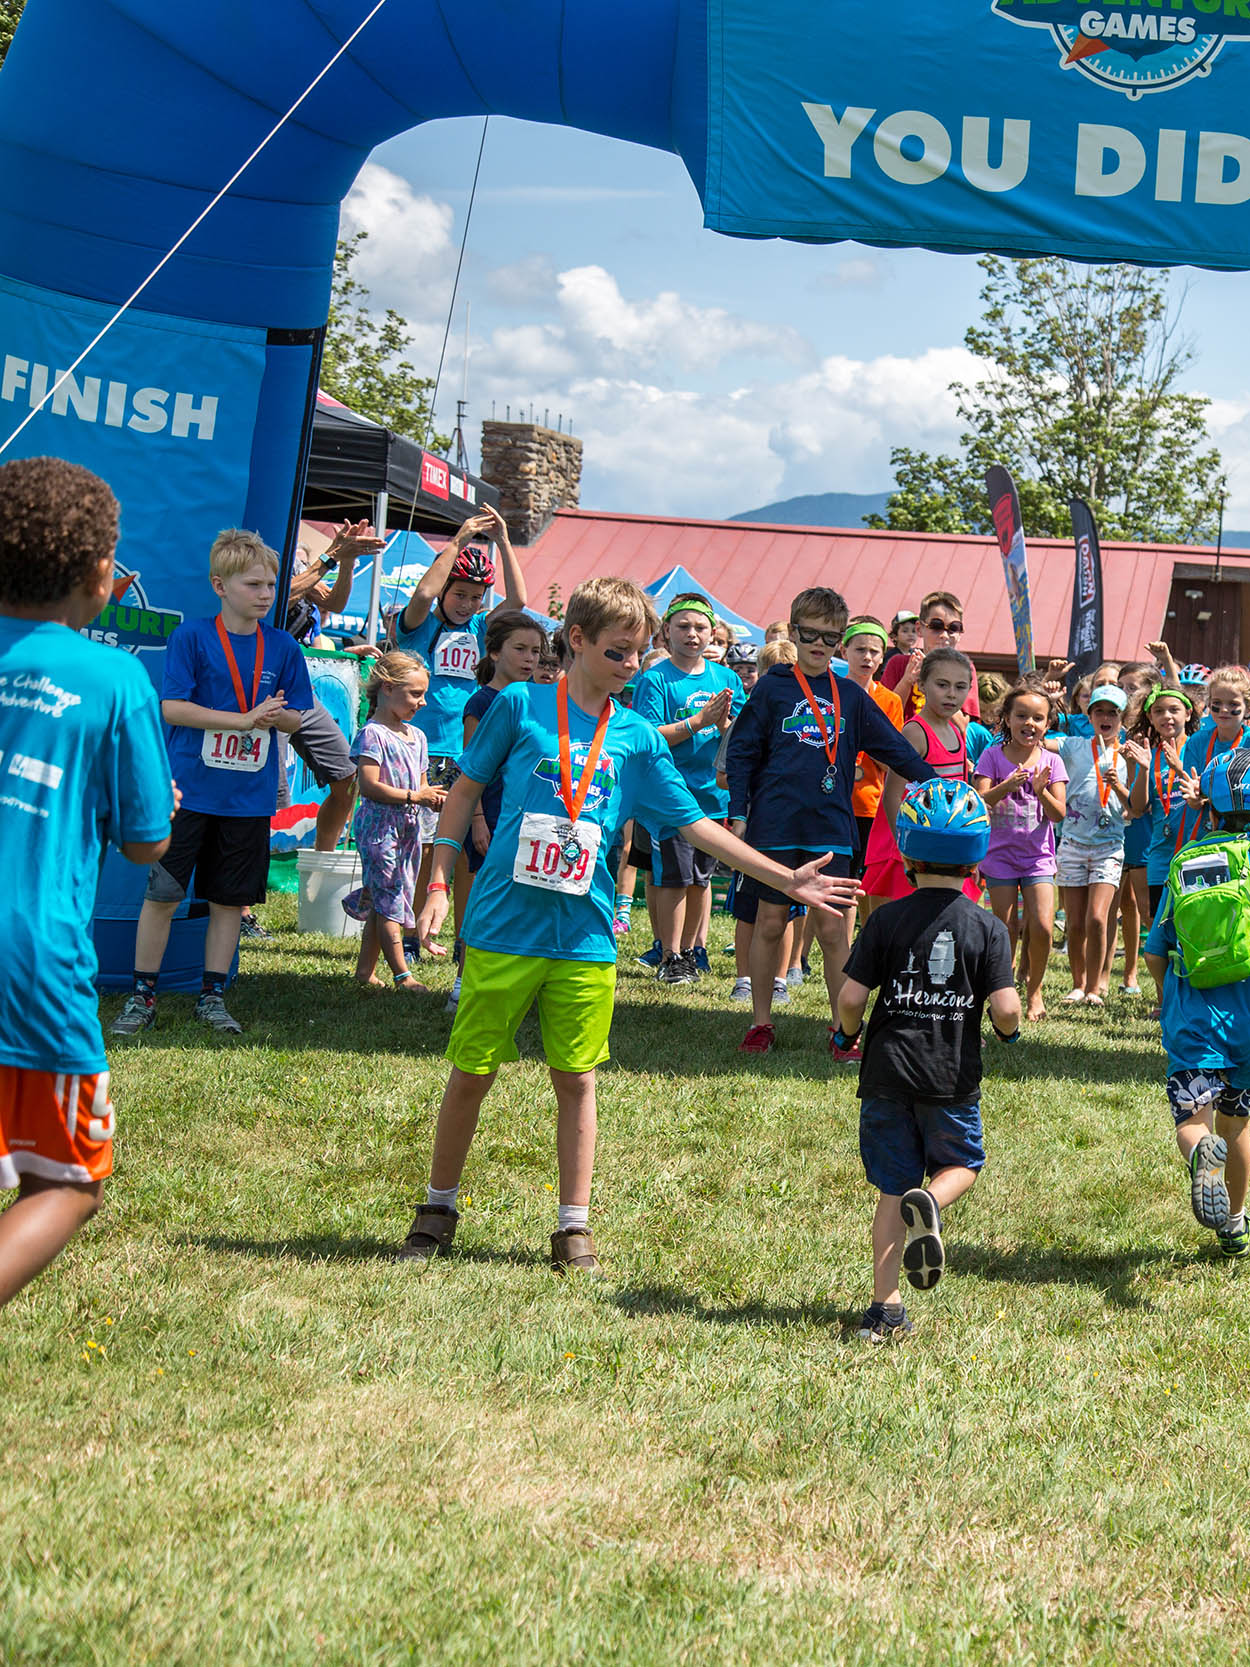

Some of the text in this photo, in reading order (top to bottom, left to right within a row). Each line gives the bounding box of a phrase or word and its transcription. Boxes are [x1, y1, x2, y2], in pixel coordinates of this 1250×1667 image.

[1079, 11, 1196, 43] GAMES
[801, 102, 1031, 192] YOU
[1, 354, 219, 440] FINISH
